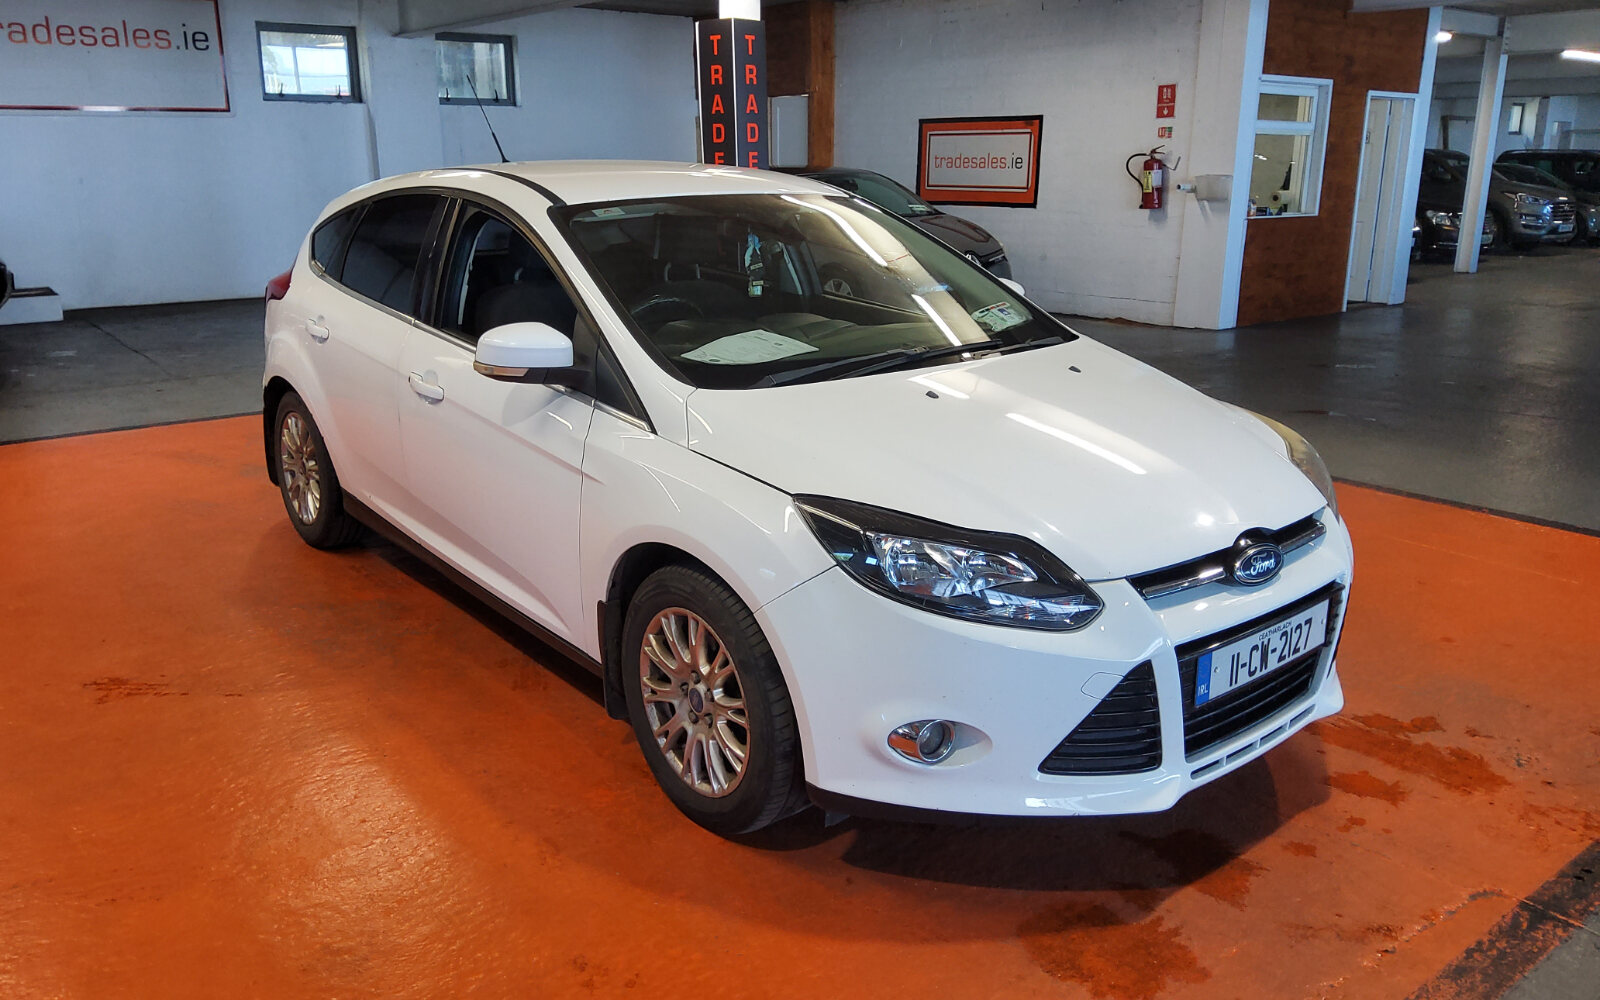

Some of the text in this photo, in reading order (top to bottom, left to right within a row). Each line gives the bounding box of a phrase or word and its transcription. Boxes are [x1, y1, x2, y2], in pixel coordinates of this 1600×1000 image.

[0, 16, 210, 51] adesales.ie
[744, 34, 759, 169] TRADE
[934, 152, 1023, 169] tradesales.ie
[1250, 552, 1276, 576] Ford
[1229, 617, 1313, 687] 11-CW-2127
[1198, 684, 1209, 697] IRL
